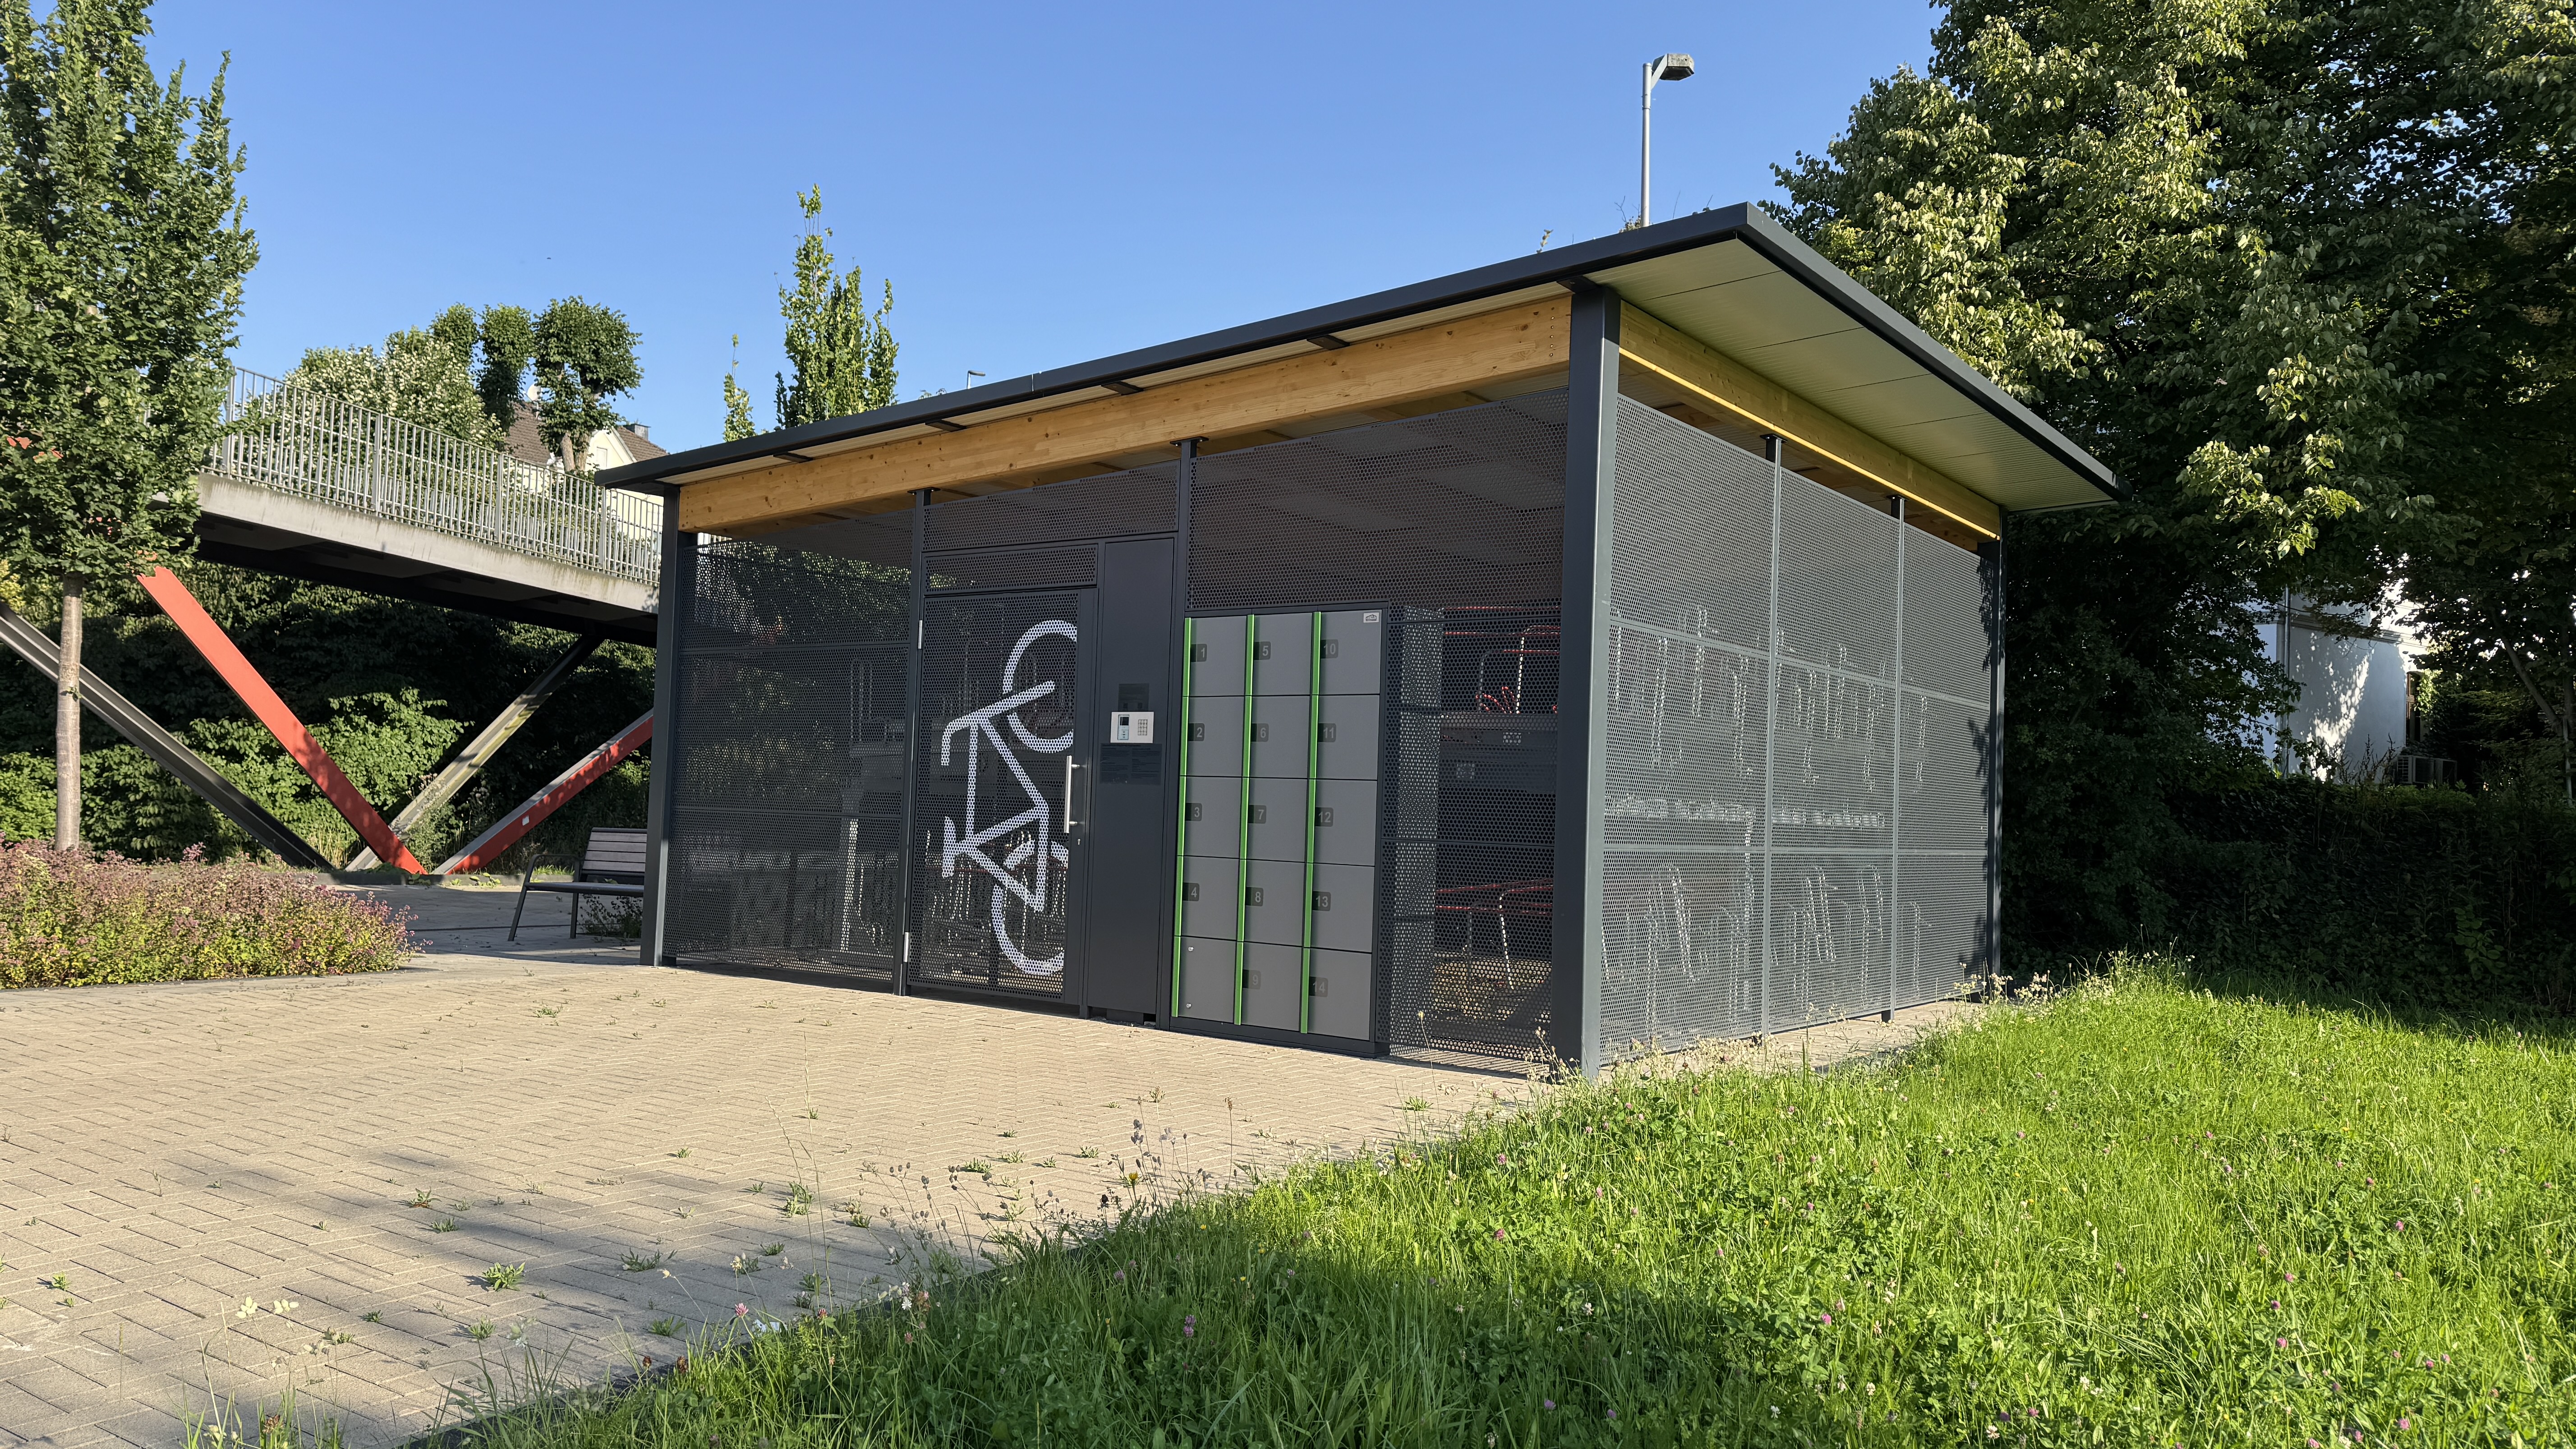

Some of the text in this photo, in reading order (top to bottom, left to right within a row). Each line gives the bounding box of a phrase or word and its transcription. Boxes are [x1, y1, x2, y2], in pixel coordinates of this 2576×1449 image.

[1201, 647, 1205, 658] 1
[1262, 645, 1269, 656] 5
[1323, 643, 1336, 655] 10
[1196, 727, 1203, 738] 2
[1260, 727, 1266, 738] 6
[1323, 727, 1334, 739] 11
[1194, 807, 1200, 818] 3
[1258, 809, 1265, 820] 7
[1318, 811, 1331, 823] 12
[1191, 887, 1197, 898] 4
[1255, 891, 1261, 903] 8
[1316, 895, 1329, 907] 13
[1252, 974, 1259, 985] 9
[1312, 980, 1325, 993] 14
